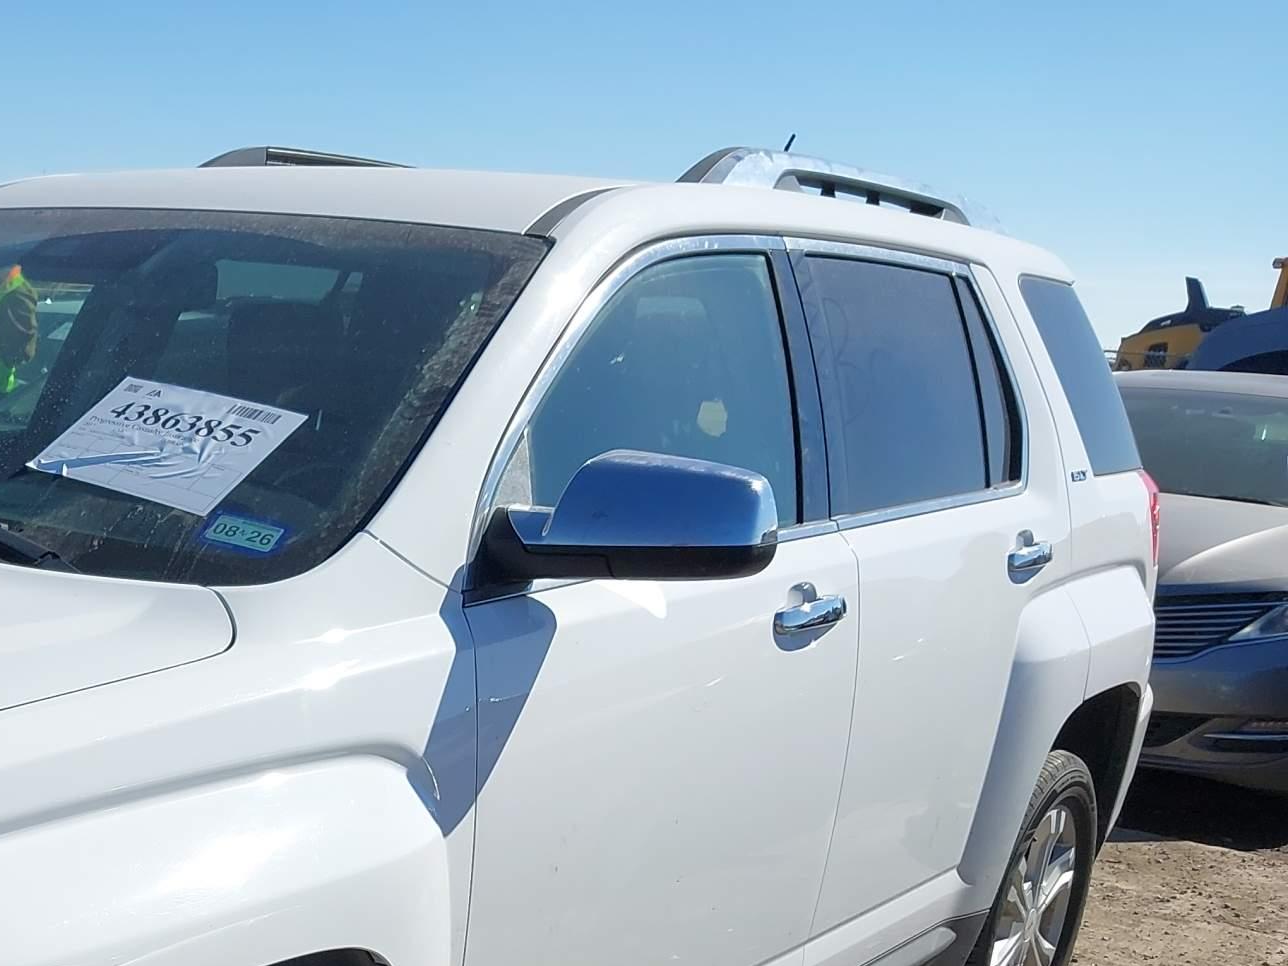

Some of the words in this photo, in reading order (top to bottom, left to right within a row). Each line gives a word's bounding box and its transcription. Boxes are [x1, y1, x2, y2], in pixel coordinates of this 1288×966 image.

[110, 401, 261, 447] 43863855
[213, 522, 240, 537] 08
[245, 530, 274, 546] 26
